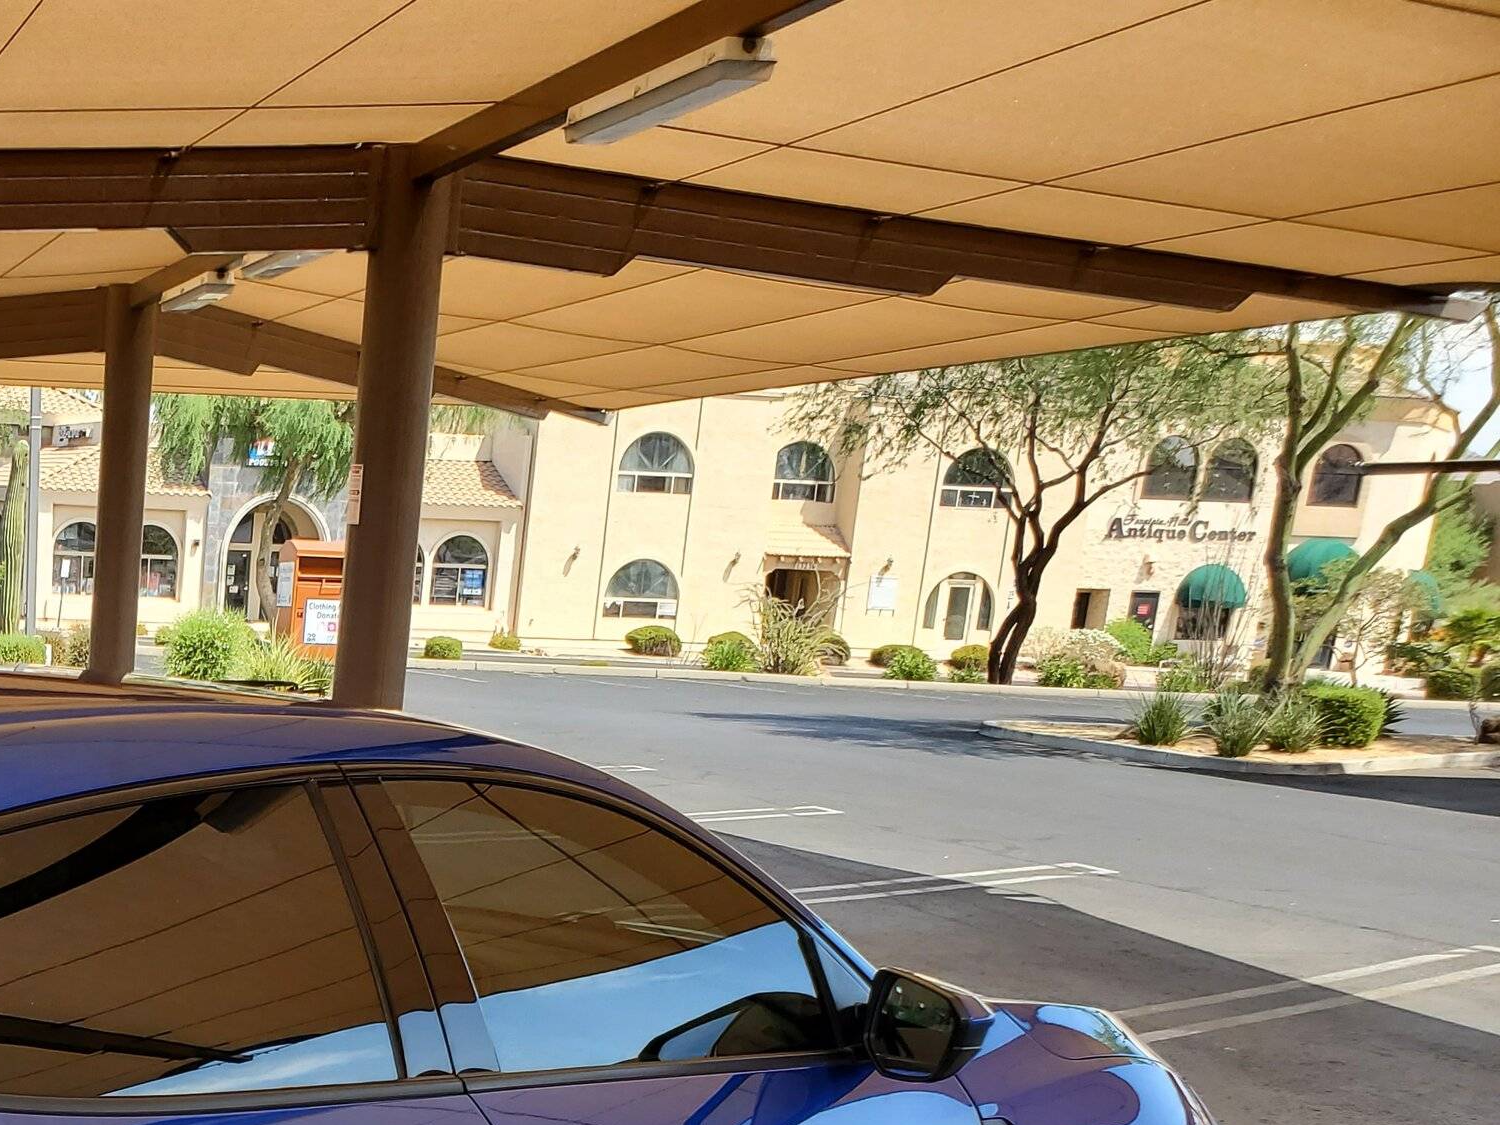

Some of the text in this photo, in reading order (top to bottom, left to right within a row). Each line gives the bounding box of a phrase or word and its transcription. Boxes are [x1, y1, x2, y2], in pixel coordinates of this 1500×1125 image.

[1105, 517, 1257, 543] Antique Center
[309, 602, 337, 612] Clothing
